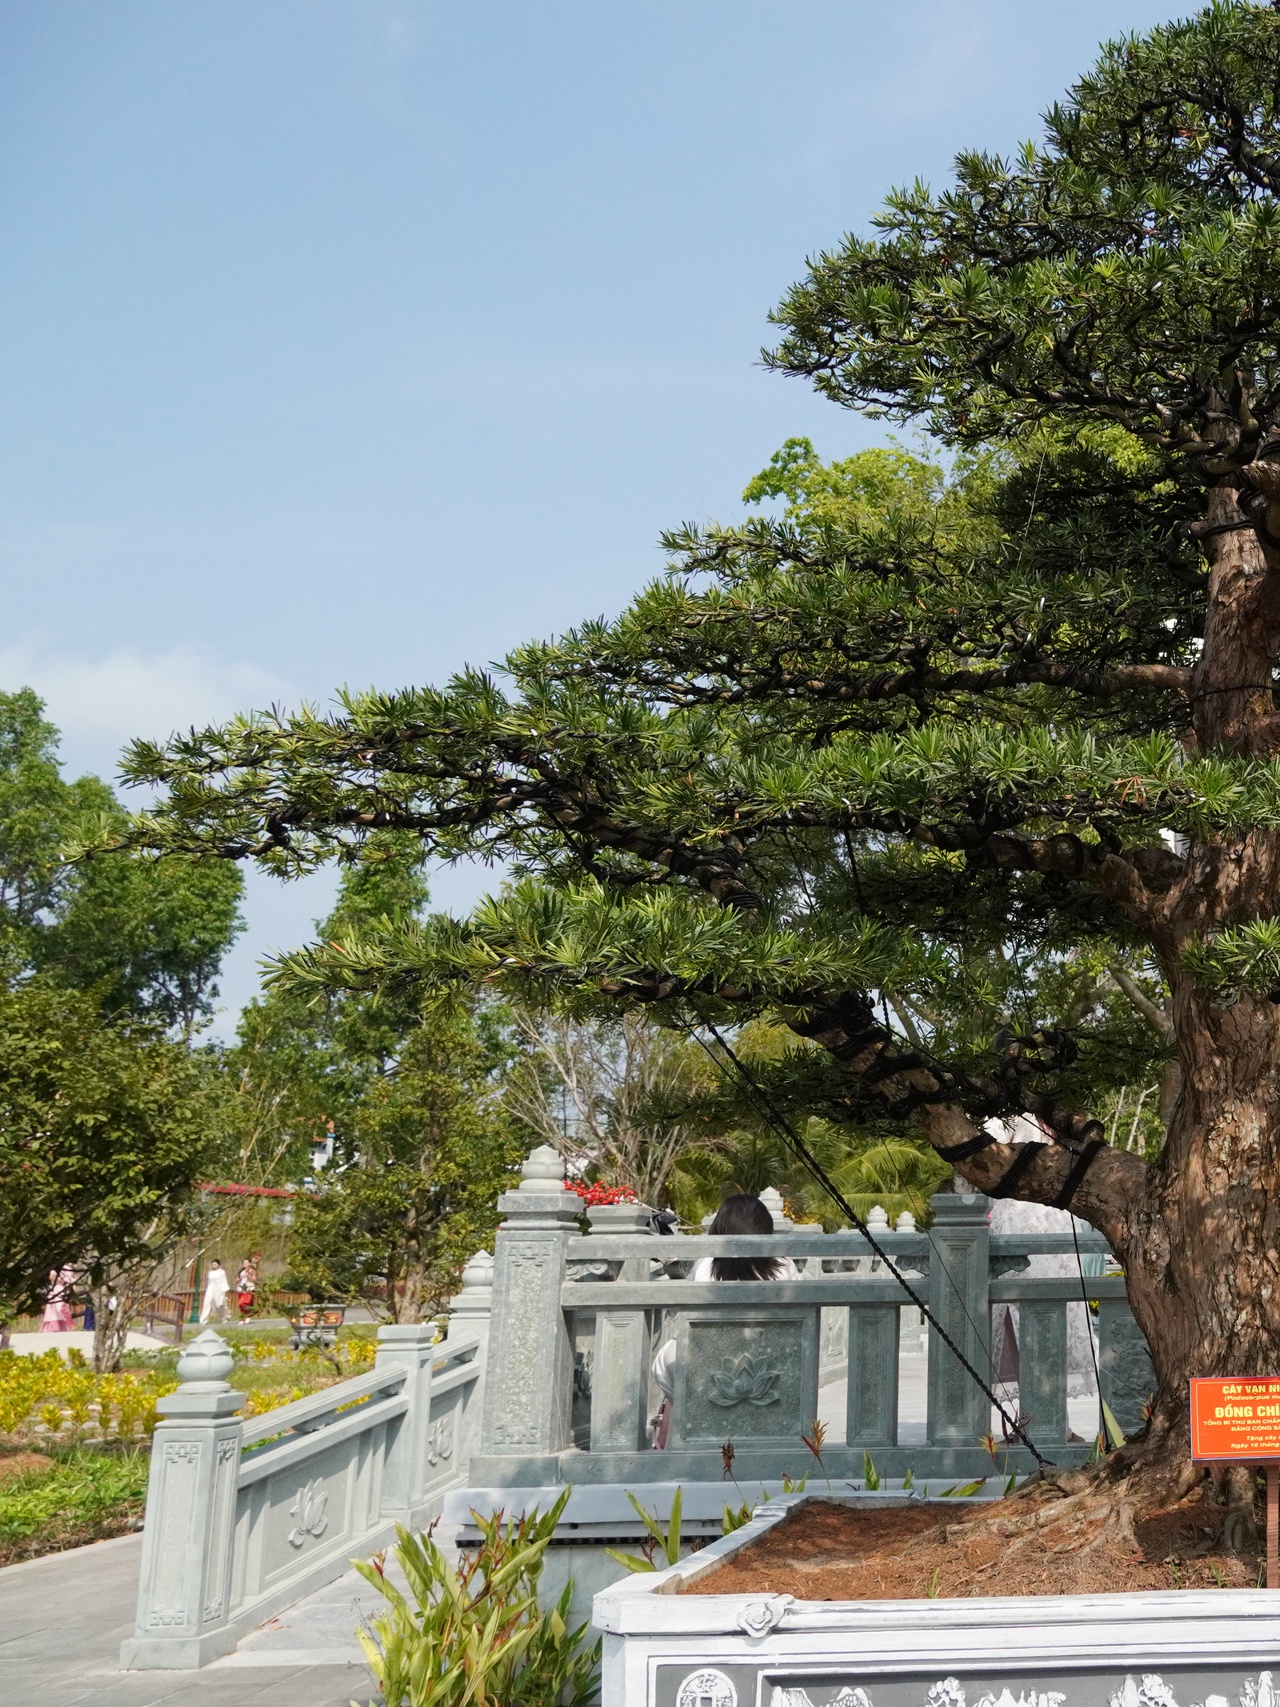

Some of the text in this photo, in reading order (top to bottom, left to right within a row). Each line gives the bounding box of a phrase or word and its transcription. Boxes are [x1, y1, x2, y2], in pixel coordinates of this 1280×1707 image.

[1222, 1384, 1242, 1394] CÂY
[1245, 1384, 1266, 1394] VẠN
[1257, 1403, 1280, 1417] CHÍ
